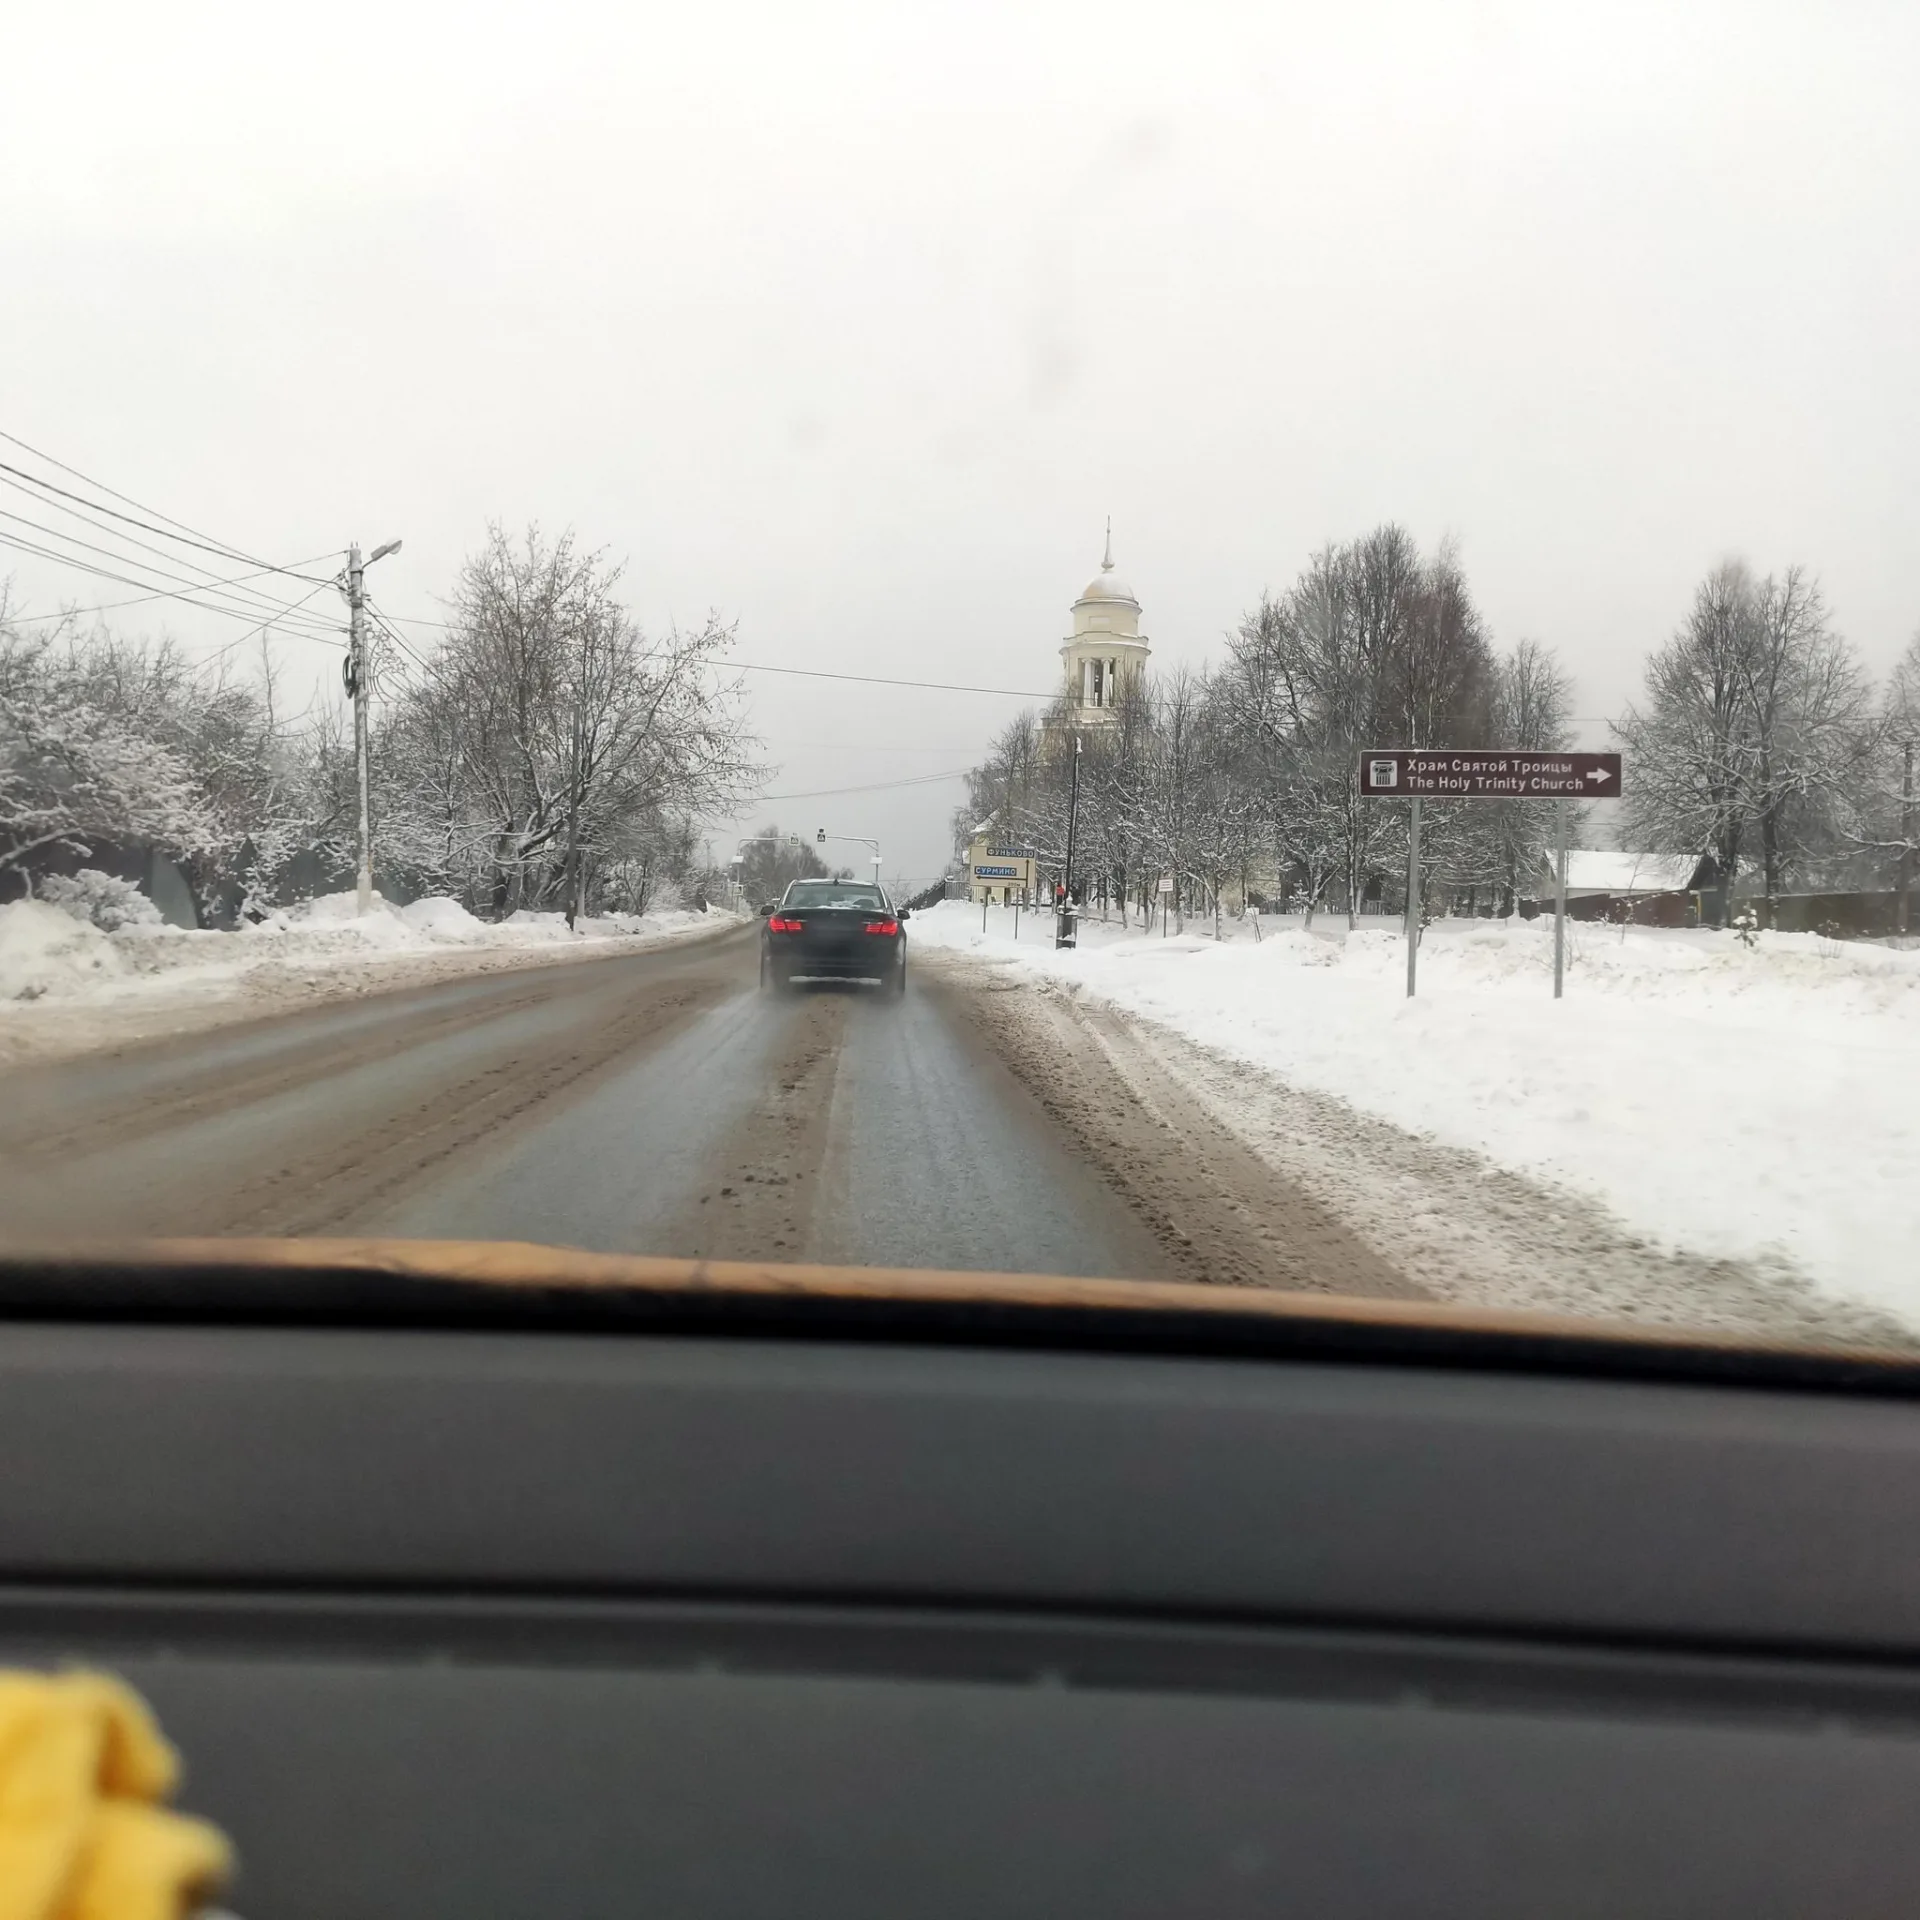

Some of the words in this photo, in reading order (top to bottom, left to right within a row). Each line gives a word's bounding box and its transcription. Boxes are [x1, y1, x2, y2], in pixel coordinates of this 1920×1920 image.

[1407, 759, 1447, 773] Храм
[1452, 758, 1507, 772] Святой
[1512, 760, 1573, 774] Троицы
[1407, 776, 1434, 789] The
[1439, 776, 1471, 791] Holy
[1476, 777, 1526, 792] Trinity
[1531, 777, 1584, 790] Church
[987, 849, 1034, 857] ФУНЬКОВО
[975, 867, 1016, 875] СУРМИНО
